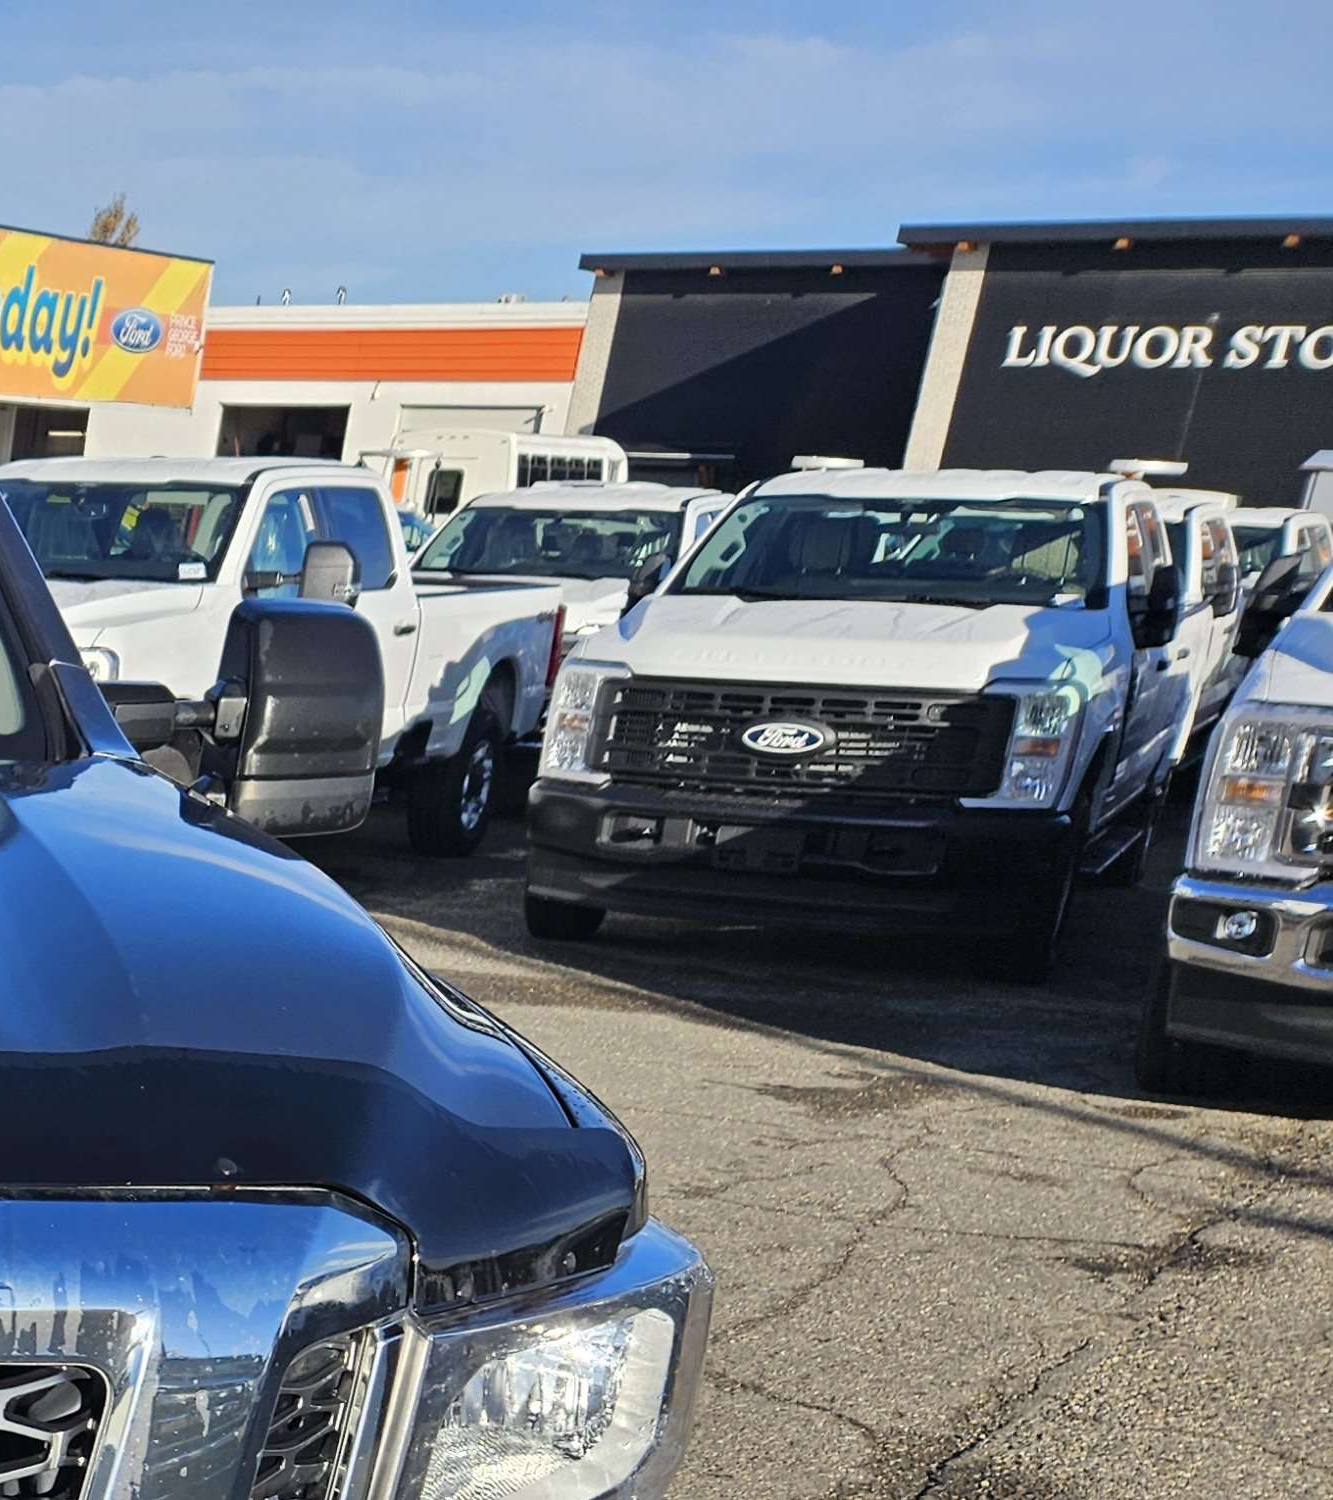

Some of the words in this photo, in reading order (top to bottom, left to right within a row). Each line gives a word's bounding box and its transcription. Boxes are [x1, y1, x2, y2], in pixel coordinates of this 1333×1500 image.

[119, 313, 155, 346] Ford
[1000, 325, 1214, 378] LIQUOR
[756, 727, 810, 749] Ford
